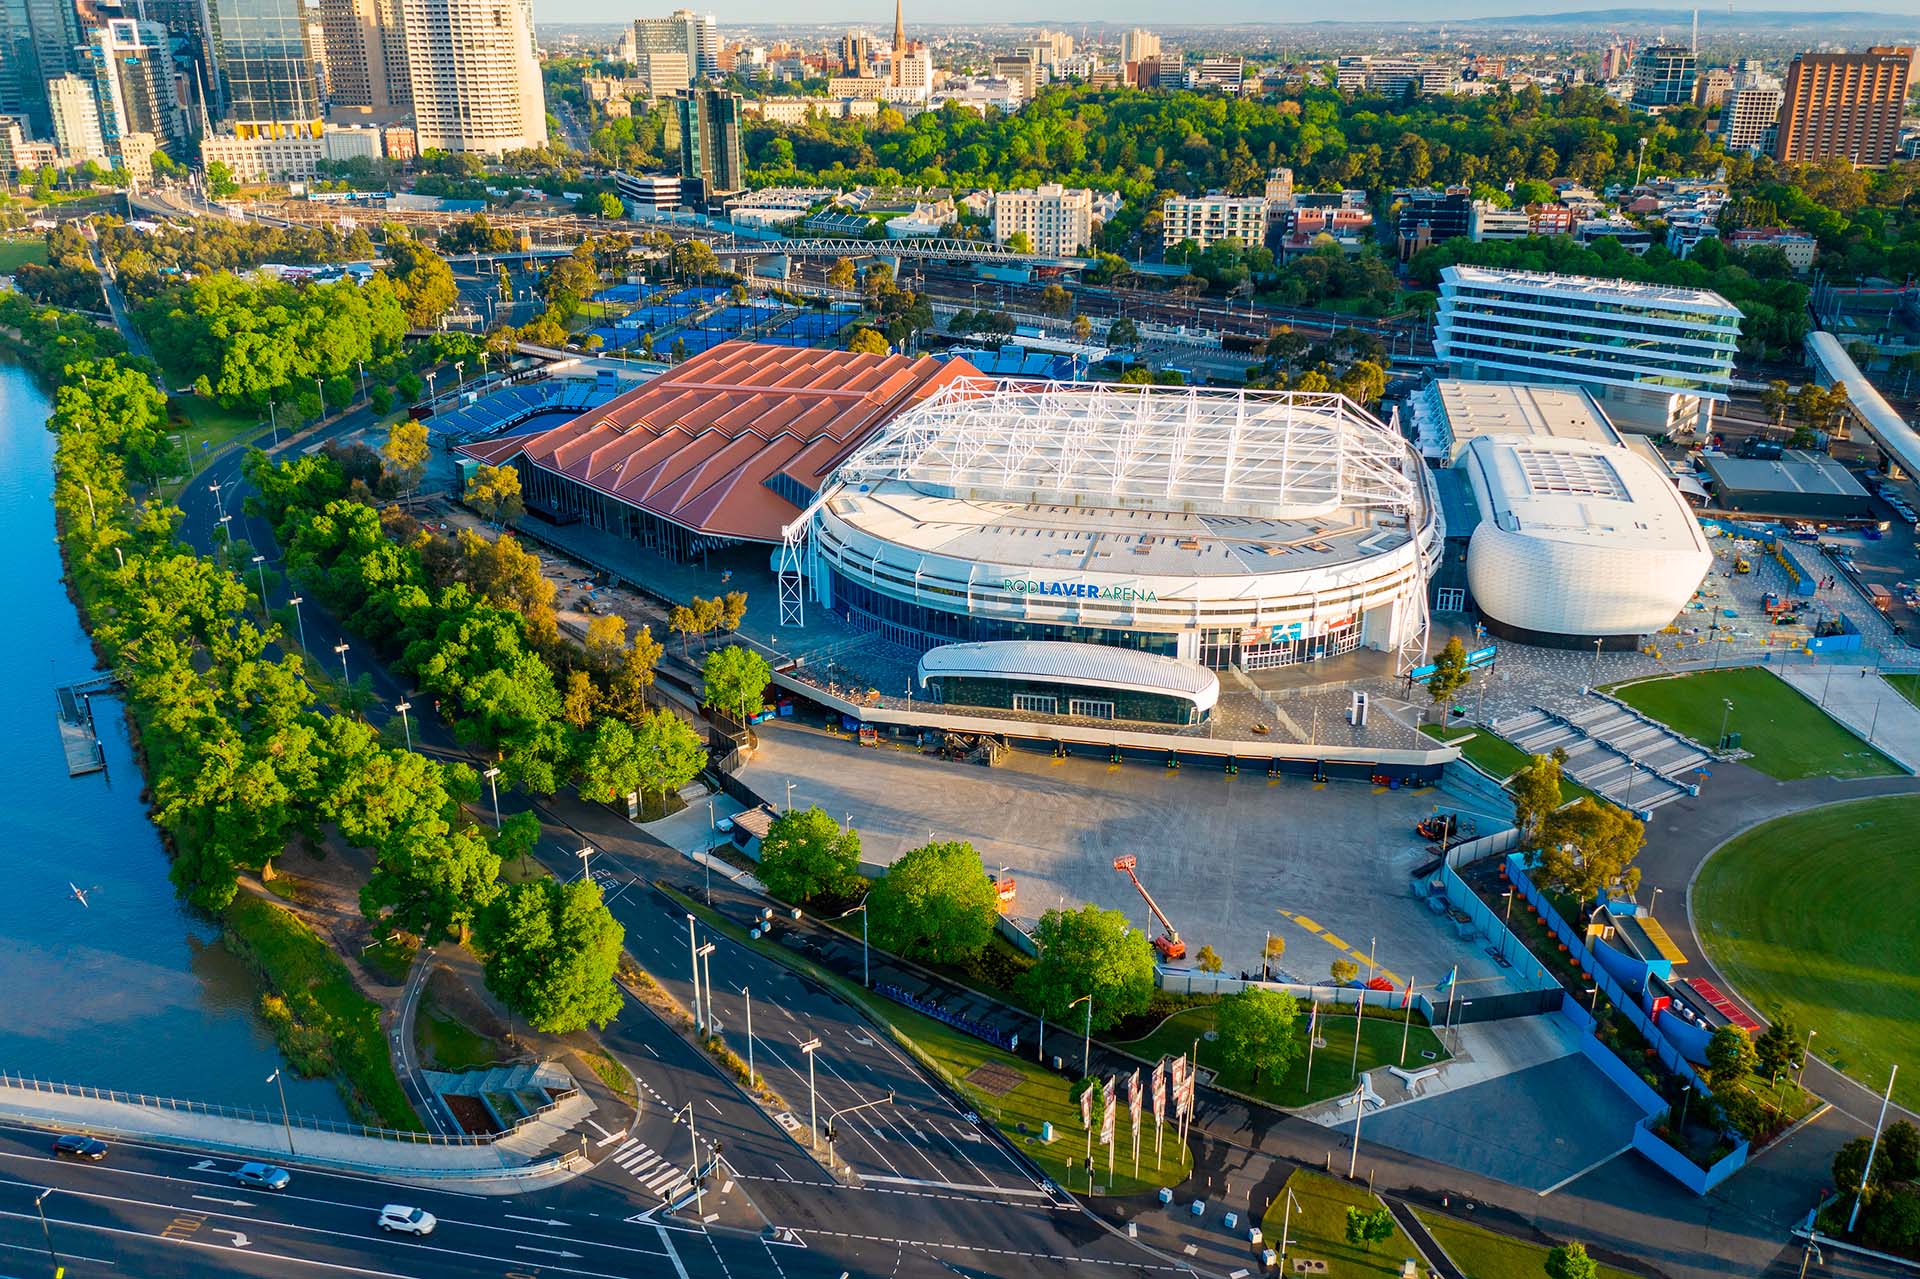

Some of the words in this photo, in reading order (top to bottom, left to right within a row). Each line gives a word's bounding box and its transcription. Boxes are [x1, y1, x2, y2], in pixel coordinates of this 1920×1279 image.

[1004, 579, 1039, 594] ROD
[1039, 581, 1100, 599] LAVER
[1101, 585, 1158, 603] ARENA
